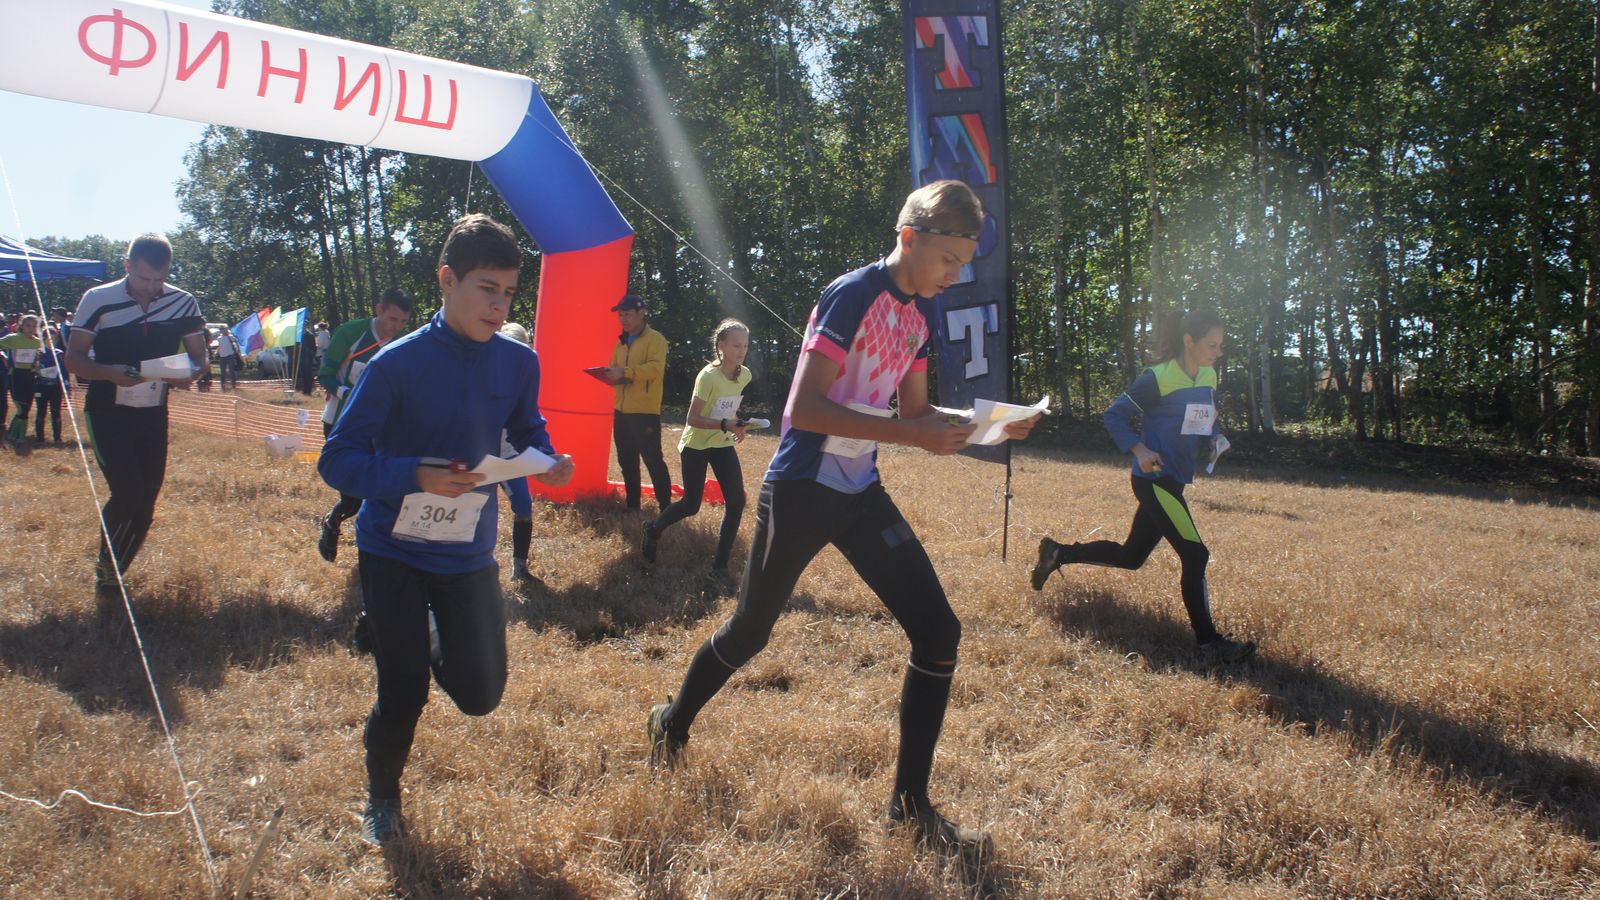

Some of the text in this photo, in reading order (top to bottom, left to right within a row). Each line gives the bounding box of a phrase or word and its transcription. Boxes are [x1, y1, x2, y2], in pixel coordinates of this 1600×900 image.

[77, 8, 458, 131] ФИНИШ
[1193, 409, 1209, 420] 704
[420, 504, 458, 524] 304
